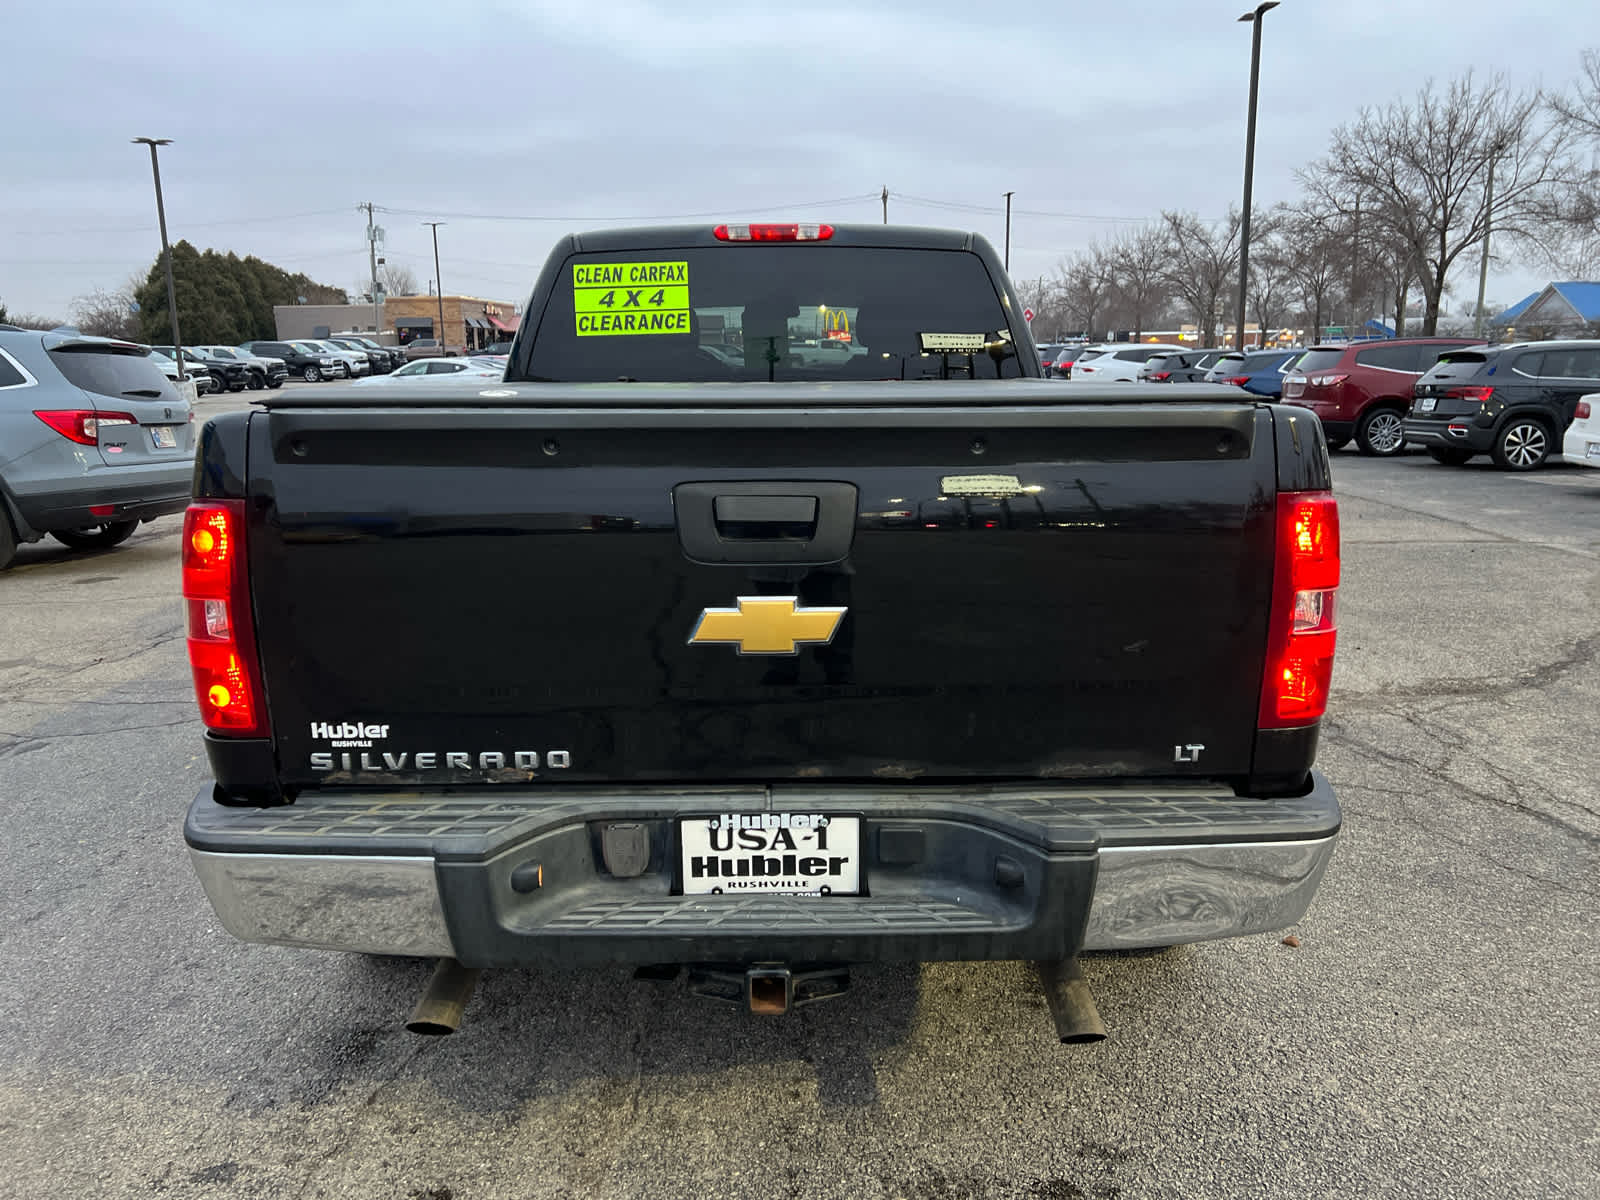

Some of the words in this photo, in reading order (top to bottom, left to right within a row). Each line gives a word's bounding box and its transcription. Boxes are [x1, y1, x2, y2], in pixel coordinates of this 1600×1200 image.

[576, 266, 623, 284] CLEAN
[630, 265, 685, 282] CARFAX
[579, 313, 687, 332] CLEARANCE
[310, 722, 390, 739] Hubler
[331, 740, 373, 748] RUSHVILLE
[1175, 743, 1205, 762] LT
[310, 750, 571, 771] SILVERADO
[720, 813, 825, 829] Hubler
[708, 826, 829, 851] USA-1
[691, 854, 849, 878] Hubler
[727, 880, 809, 888] RUSHVILLE
